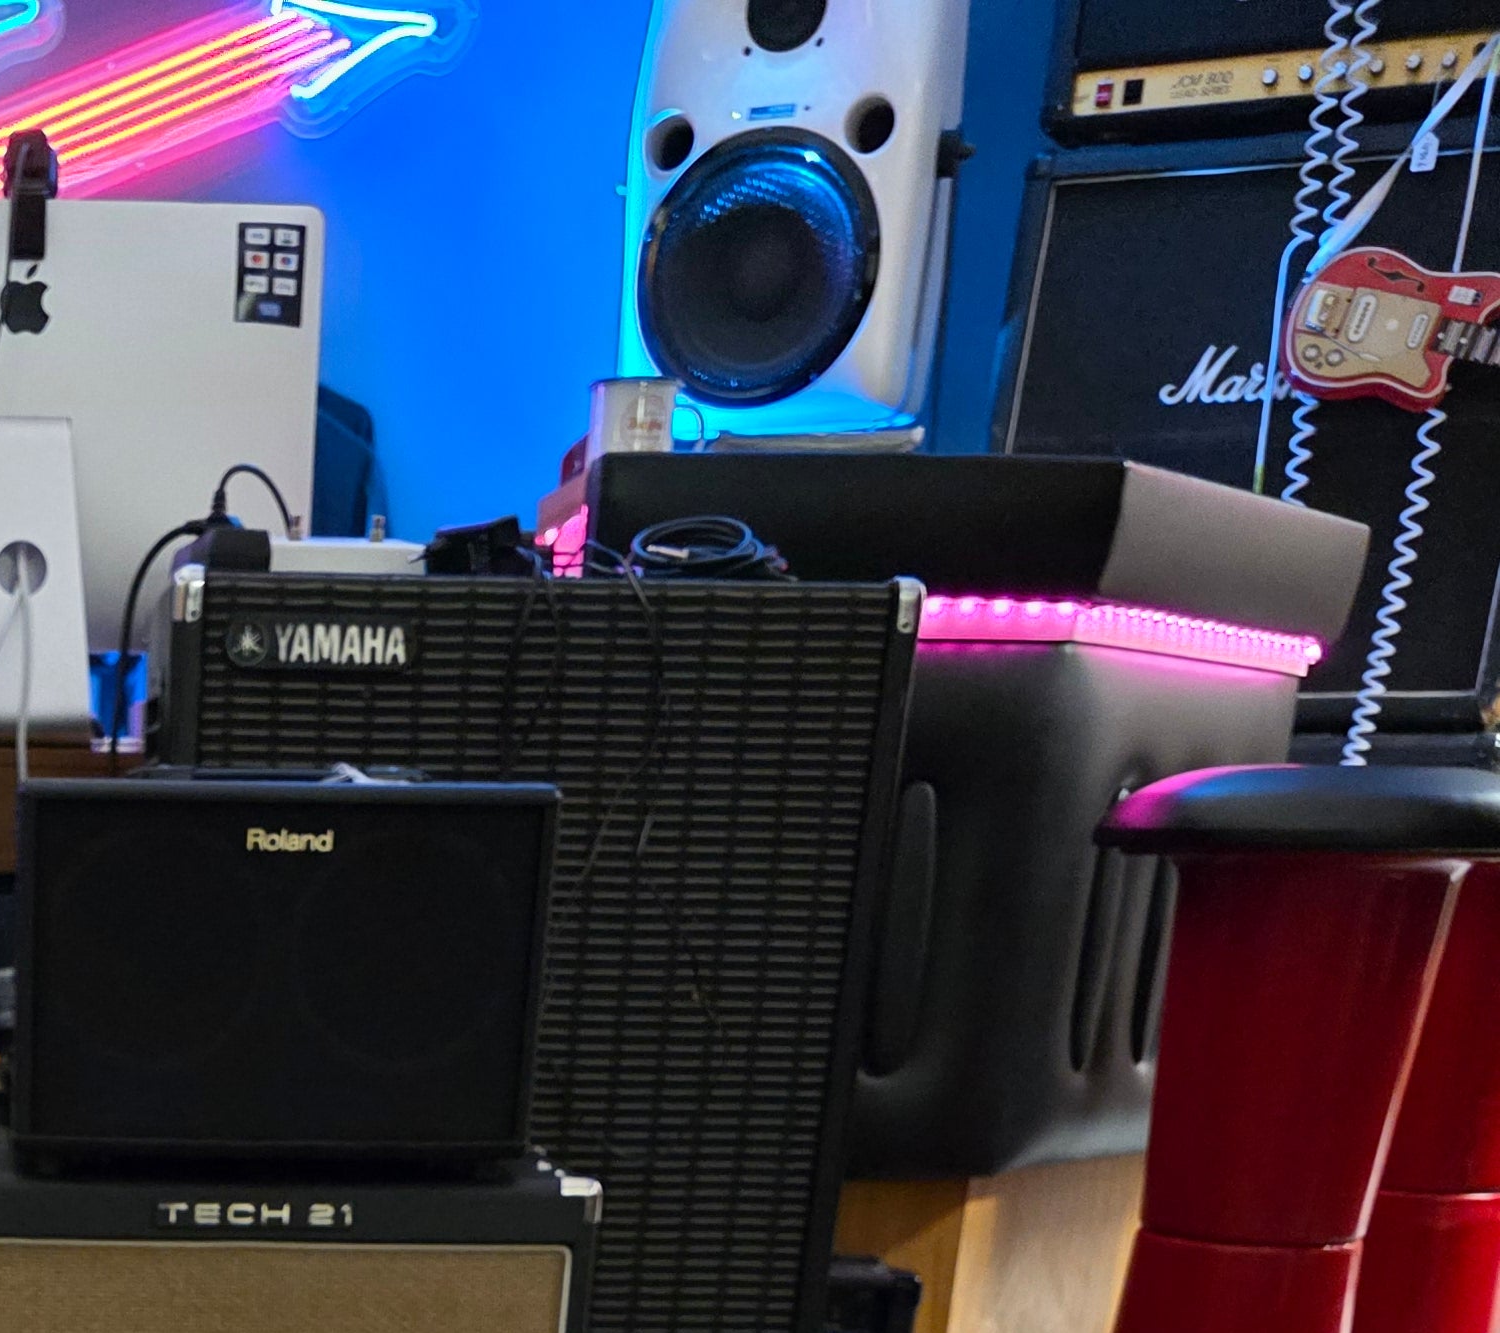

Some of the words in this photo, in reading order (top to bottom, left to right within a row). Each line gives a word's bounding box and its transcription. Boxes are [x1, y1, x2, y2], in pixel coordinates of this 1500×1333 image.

[275, 622, 407, 665] YAMAHA
[246, 826, 335, 852] Roland
[158, 1202, 291, 1226] TECH
[308, 1203, 353, 1226] 21
